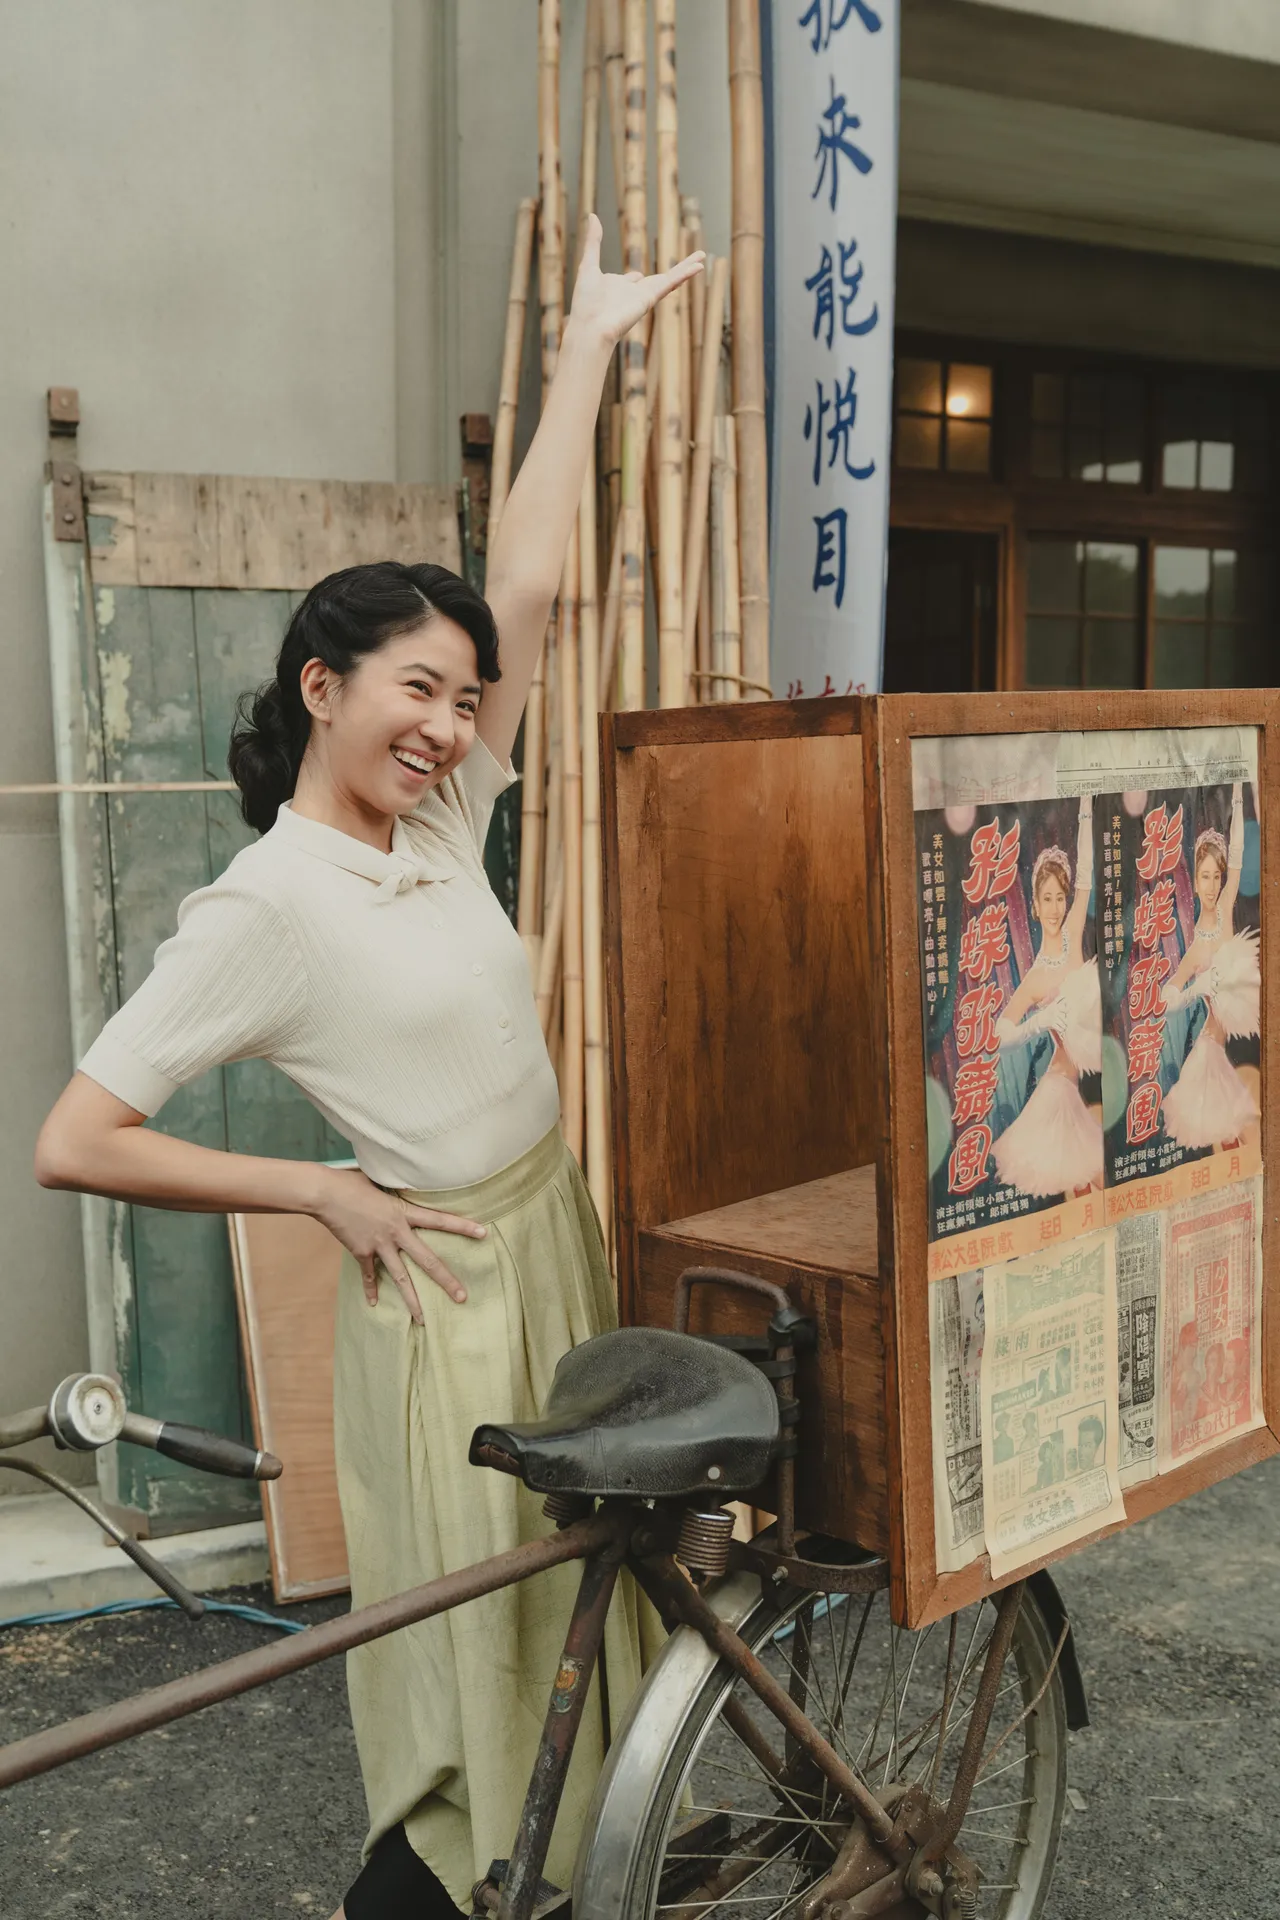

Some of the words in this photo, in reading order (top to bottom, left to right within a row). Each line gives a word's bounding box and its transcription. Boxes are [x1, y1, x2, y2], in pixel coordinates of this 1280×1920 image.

[948, 816, 1021, 1193] 彩蝶歌舞團
[1126, 801, 1184, 1144] 彩蝶歌舞團
